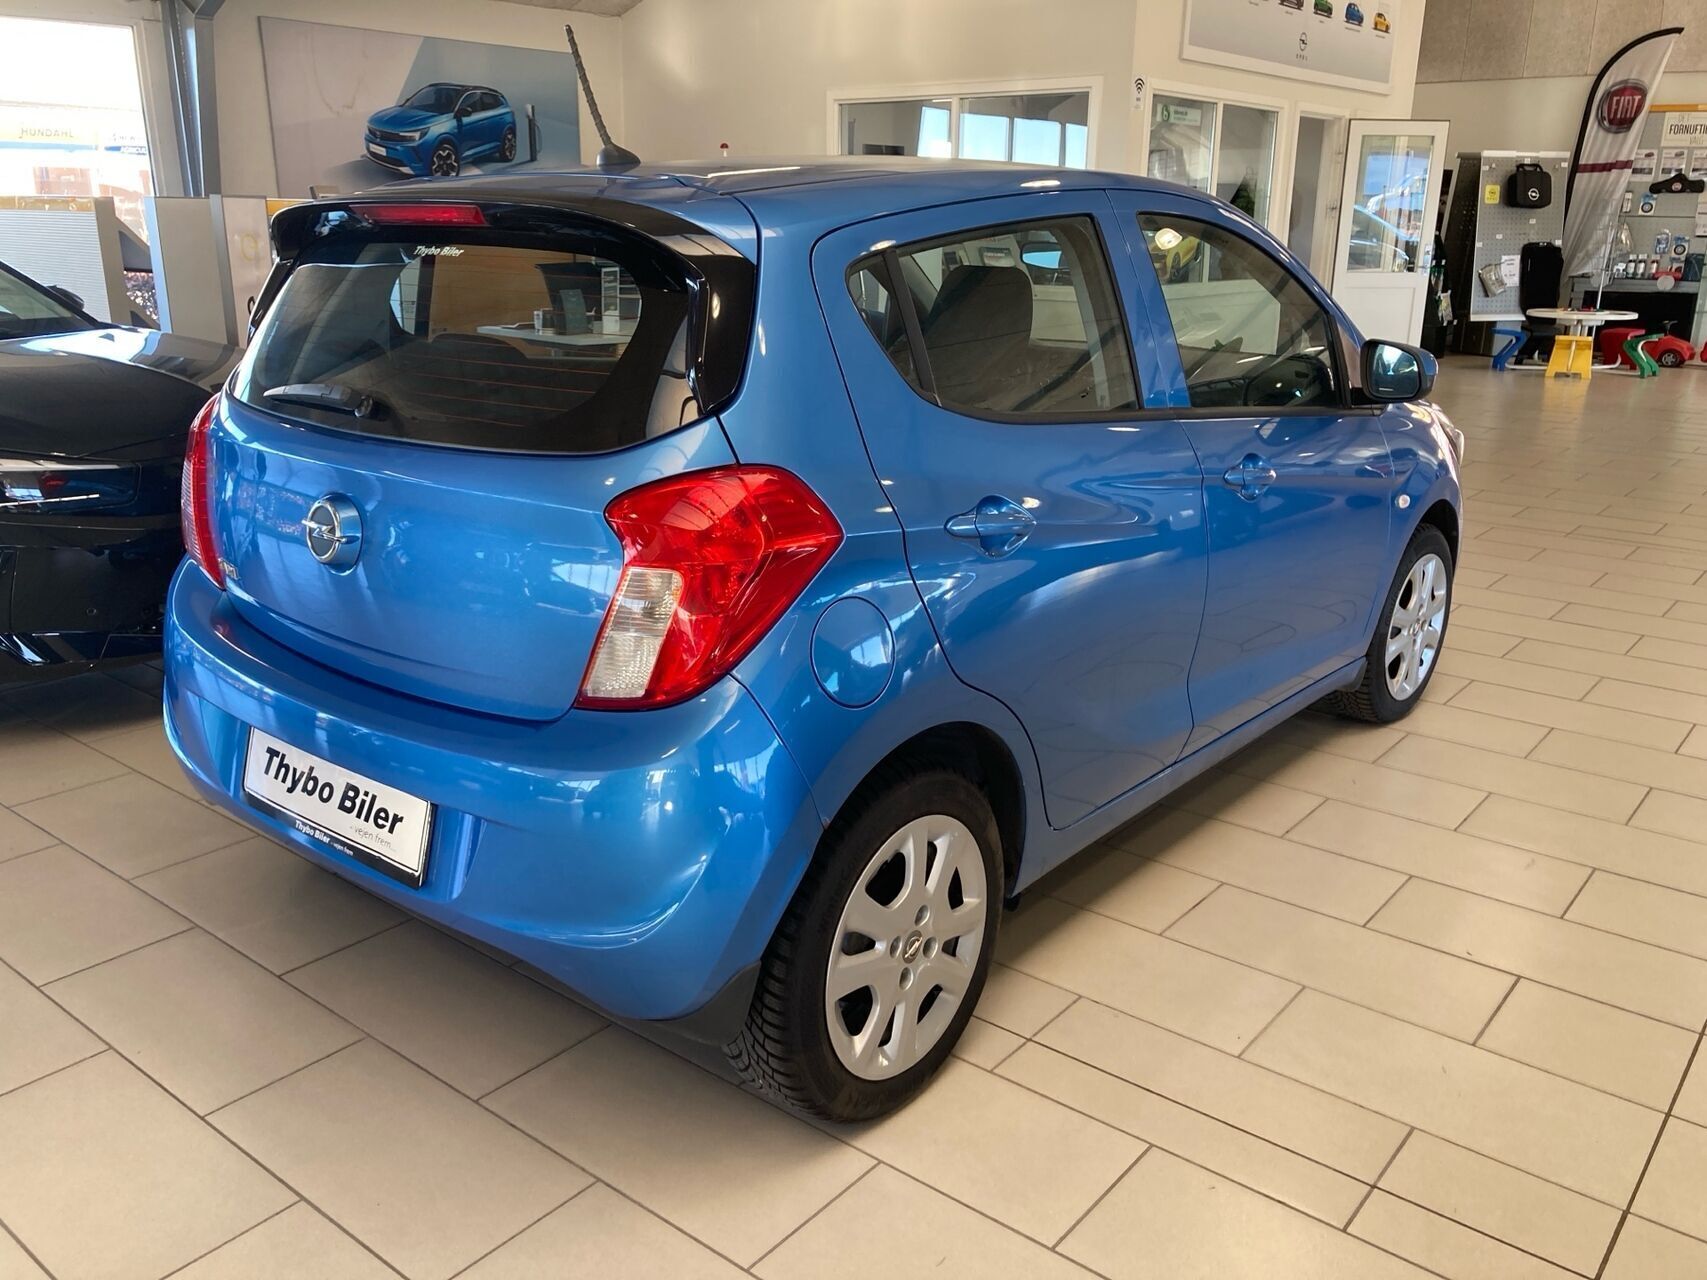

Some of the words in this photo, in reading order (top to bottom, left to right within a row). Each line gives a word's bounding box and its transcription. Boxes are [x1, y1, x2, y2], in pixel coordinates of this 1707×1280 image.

[1610, 95, 1642, 119] FIAT
[1669, 123, 1707, 135] FORNUFTI
[414, 246, 440, 256] Thybo
[440, 246, 464, 256] Biler
[264, 746, 334, 803] Thybo
[337, 782, 404, 835] Biler
[295, 820, 314, 836] Thybo
[314, 828, 331, 844] Biler
[355, 825, 374, 839] vejen
